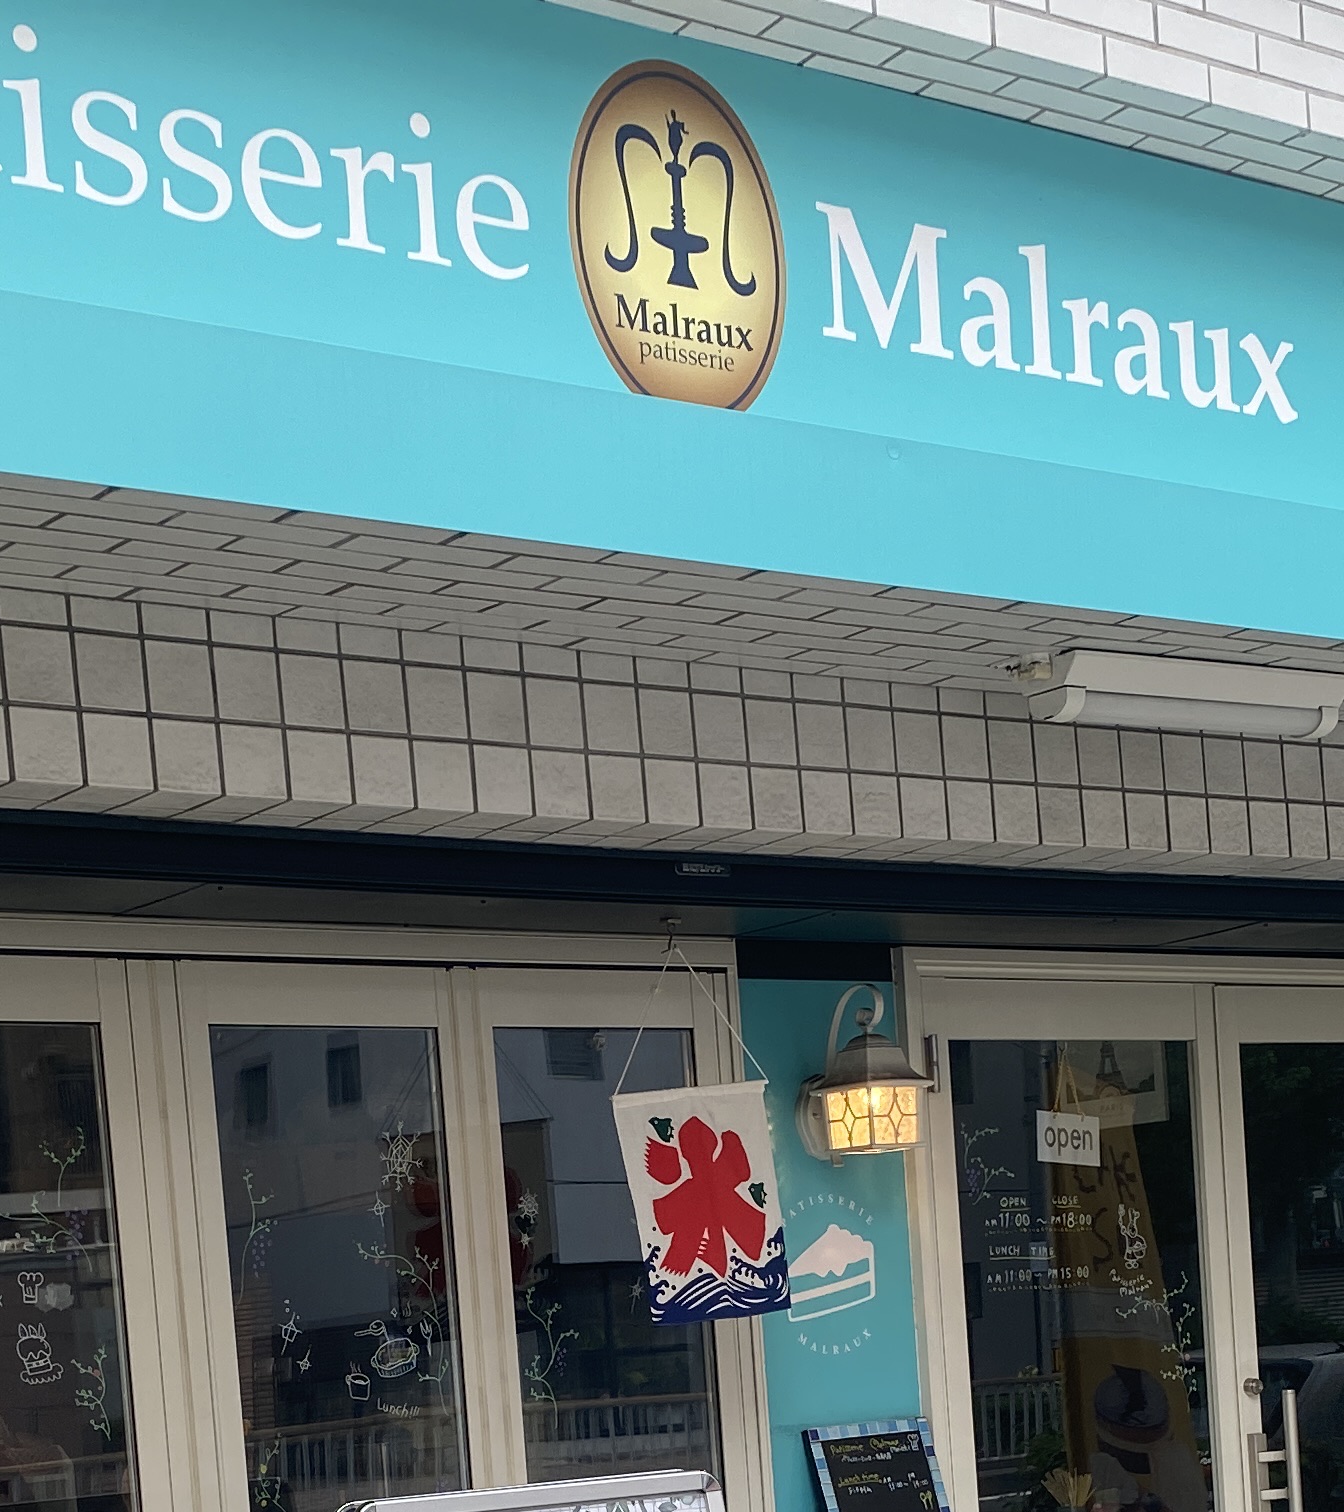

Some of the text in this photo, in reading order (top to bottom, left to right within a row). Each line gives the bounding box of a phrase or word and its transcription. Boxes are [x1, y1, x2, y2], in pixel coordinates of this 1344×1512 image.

[613, 292, 754, 352] Malraux
[815, 201, 1299, 425] Malraux
[639, 340, 735, 372] patisserie
[1044, 1125, 1094, 1157] open
[1000, 1195, 1079, 1208] OPEN CLOSE
[989, 1245, 1054, 1258] LUNCH TIME
[798, 1327, 872, 1355] MALRAUX
